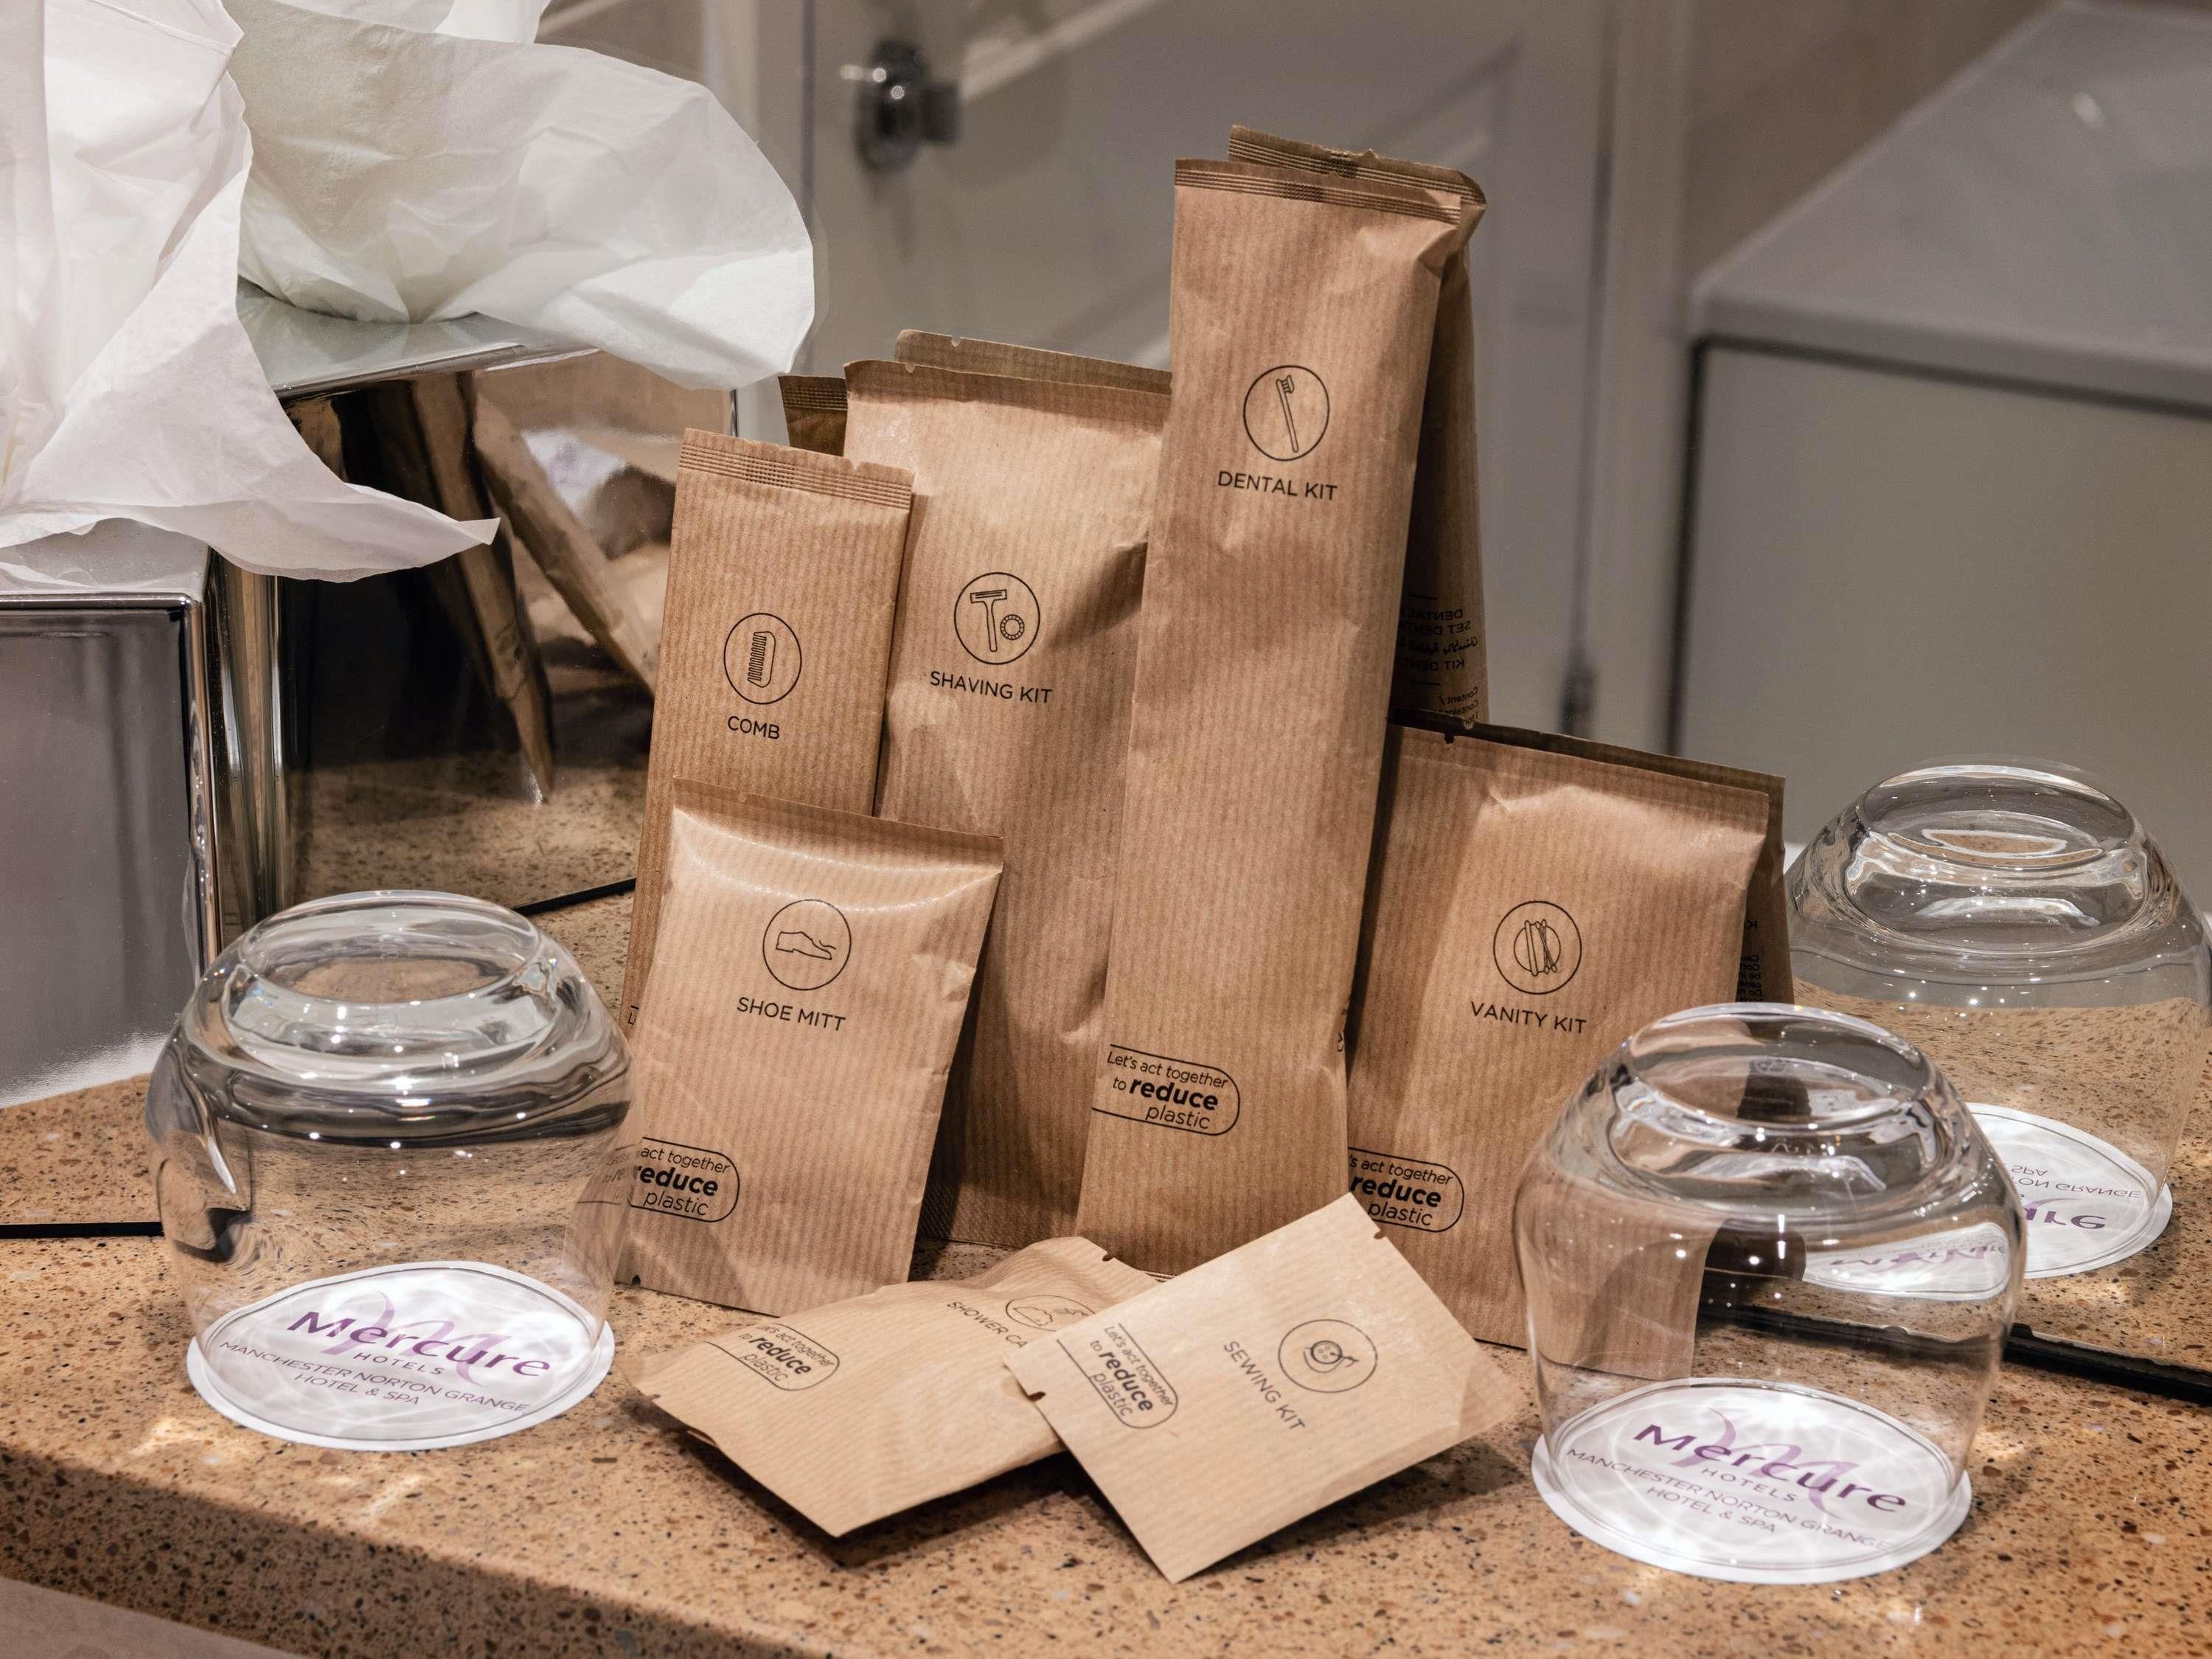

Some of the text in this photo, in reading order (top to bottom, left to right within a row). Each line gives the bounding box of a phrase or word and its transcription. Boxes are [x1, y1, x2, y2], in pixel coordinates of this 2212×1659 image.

[1217, 470, 1338, 501] DENTAL KIT
[929, 671, 1053, 704] SHAVING KIT
[727, 715, 781, 740] COMB
[737, 997, 846, 1031] SHOE MITT
[1470, 1001, 1587, 1034] VANITY KIT
[1107, 1051, 1228, 1088] Let's act together
[1113, 1077, 1219, 1110] to reduce
[1145, 1105, 1211, 1130] plastic
[640, 1146, 731, 1174] act together
[1361, 1160, 1385, 1173] act
[1388, 1163, 1453, 1185] together
[643, 1190, 709, 1216] plastic
[1349, 1175, 1441, 1208] reduce
[1368, 1201, 1433, 1226] plastic
[947, 1301, 1029, 1349] SHOWER CA
[287, 1311, 552, 1377] Mercure
[749, 1337, 812, 1374] reduce
[776, 1332, 796, 1343] act
[791, 1340, 835, 1366] together
[219, 1340, 531, 1414] MANCHESTER NORTON GRANGE
[353, 1351, 446, 1376] HOTELS
[740, 1354, 789, 1382] plastic
[1090, 1340, 1153, 1411] to reduce
[1104, 1326, 1173, 1405] Let's act together
[294, 1372, 421, 1407] HOTEL & SPA
[1090, 1373, 1133, 1416] plastic
[1222, 1339, 1306, 1431] SEWING KIT
[1632, 1424, 1907, 1512] Mercure
[1700, 1467, 1799, 1502] HOTELS
[1566, 1448, 1703, 1495] MANCHESTER
[1704, 1488, 1798, 1525] NORTON
[1646, 1484, 1777, 1534] HOTEL & SPA
